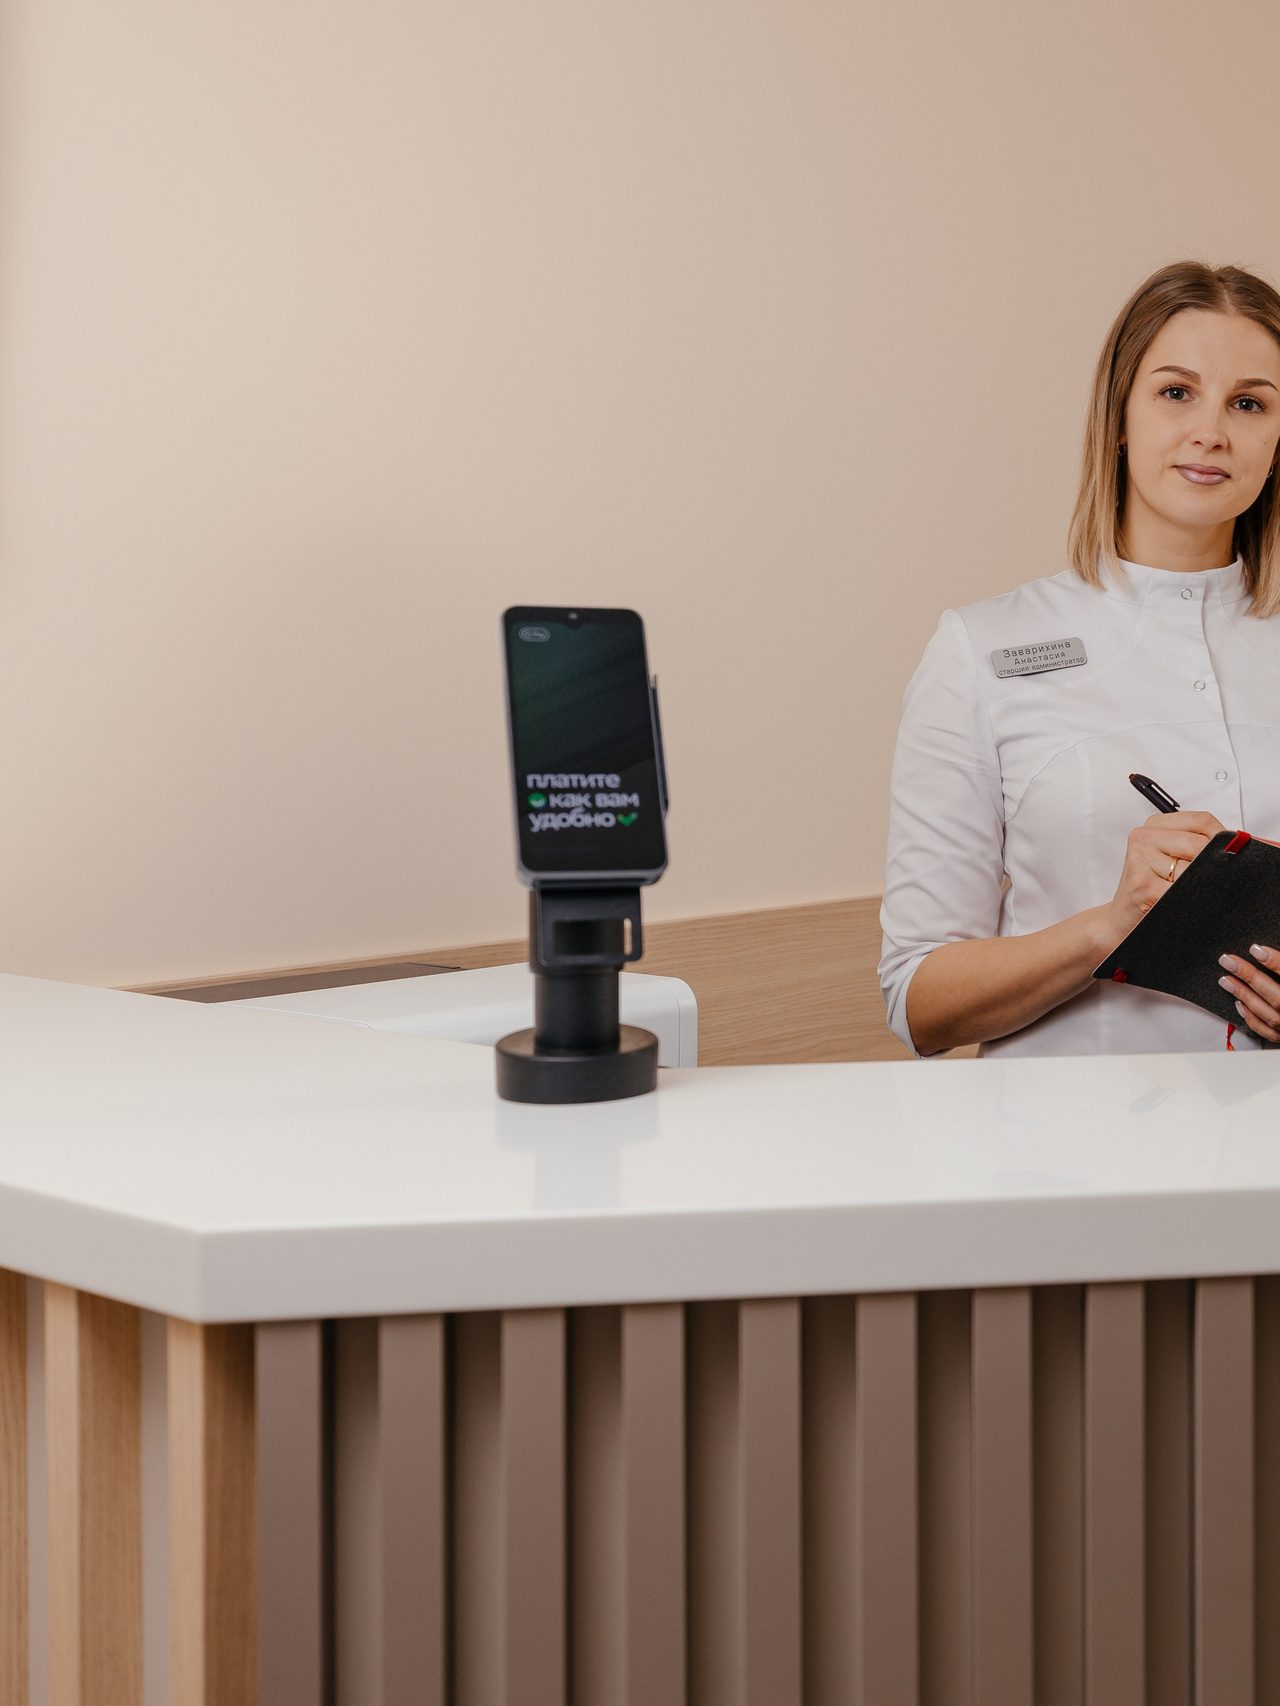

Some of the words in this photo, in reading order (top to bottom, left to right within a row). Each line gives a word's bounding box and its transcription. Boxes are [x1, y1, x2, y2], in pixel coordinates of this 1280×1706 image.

[1003, 641, 1071, 658] Заварихина
[1014, 651, 1066, 665] Анастасия
[999, 665, 1030, 676] старший
[1031, 657, 1084, 671] администратор
[526, 773, 621, 789] платите
[549, 793, 592, 808] как
[595, 793, 640, 808] вам
[528, 807, 616, 833] удобно
